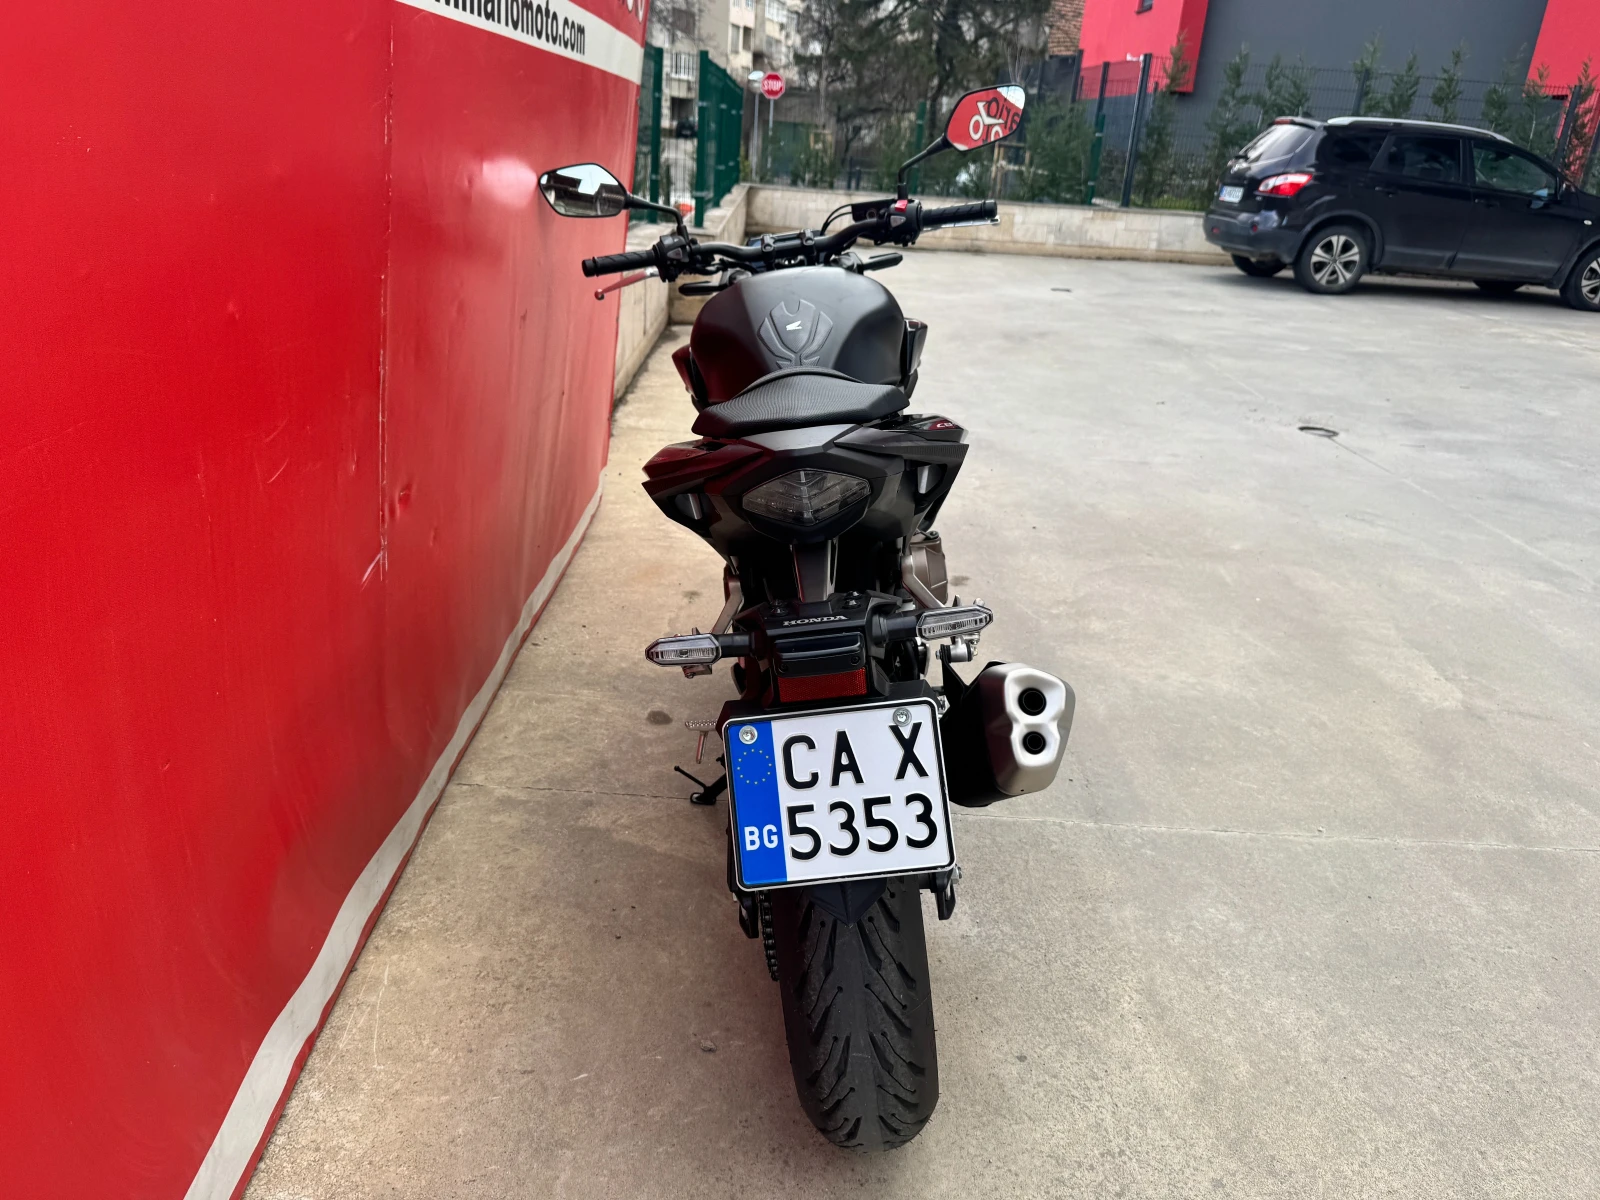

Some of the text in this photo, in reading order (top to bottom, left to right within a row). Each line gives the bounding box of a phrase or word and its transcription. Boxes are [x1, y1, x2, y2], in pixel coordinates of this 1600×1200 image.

[762, 79, 783, 92] STOP
[782, 615, 849, 627] HONDA
[782, 721, 929, 790] CA X
[743, 823, 779, 851] BG
[786, 793, 938, 861] 5353
